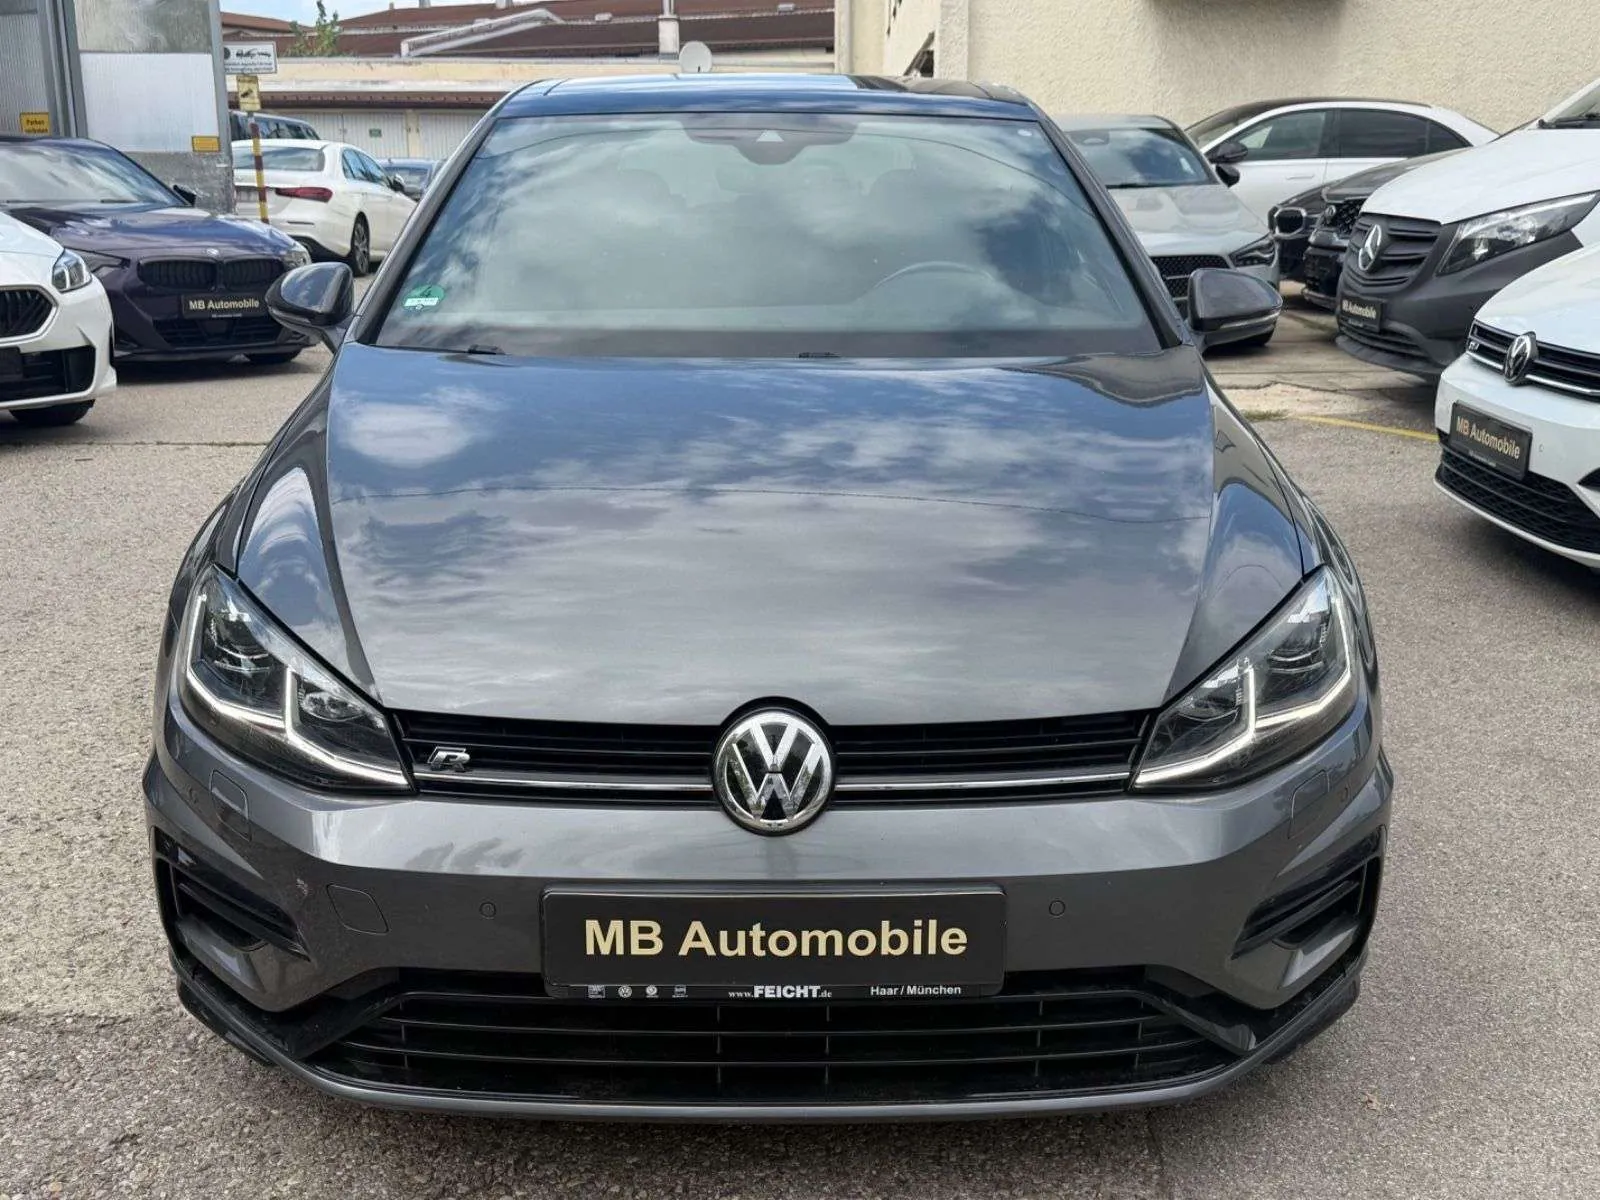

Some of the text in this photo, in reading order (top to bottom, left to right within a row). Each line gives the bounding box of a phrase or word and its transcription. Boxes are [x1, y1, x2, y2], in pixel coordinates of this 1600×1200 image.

[189, 298, 260, 310] MB Automobile
[1456, 415, 1470, 436] MB
[1470, 422, 1521, 460] Automobile
[584, 919, 968, 957] MB Automobile
[728, 985, 832, 999] www.FEICHT.de
[870, 986, 899, 996] Haar
[906, 985, 961, 995] München
